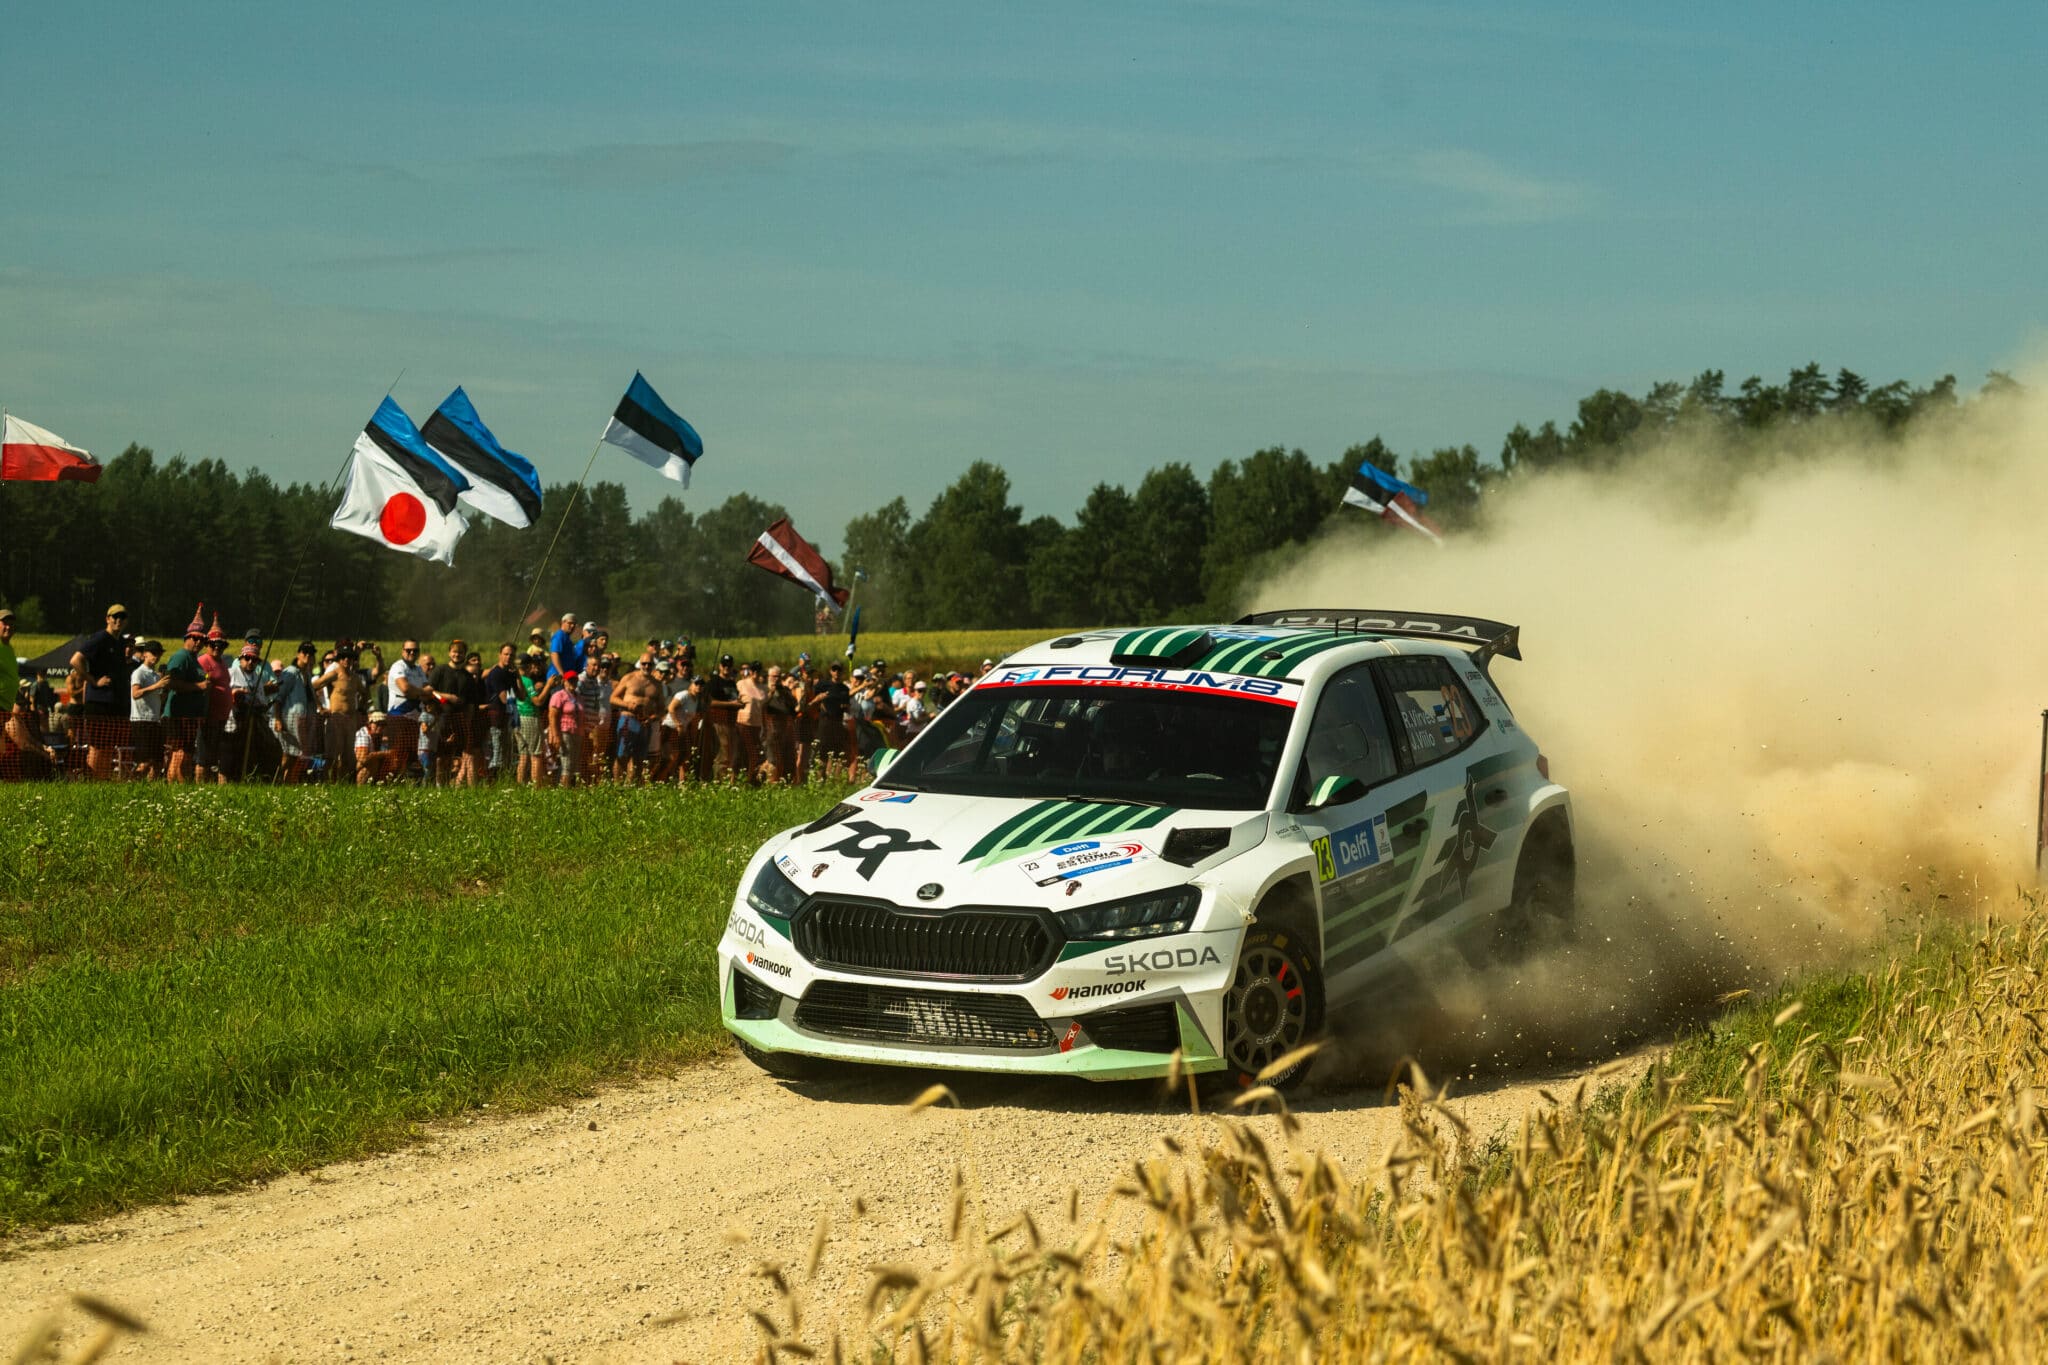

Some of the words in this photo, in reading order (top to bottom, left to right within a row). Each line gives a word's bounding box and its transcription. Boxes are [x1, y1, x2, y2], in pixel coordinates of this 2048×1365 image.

[1043, 667, 1283, 696] FORUM8
[1441, 685, 1473, 738] 23
[1056, 851, 1120, 867] ESTONIA
[1063, 844, 1089, 853] Delfi
[1313, 837, 1335, 881] 23
[1339, 831, 1371, 865] Delfi
[1024, 862, 1040, 871] 23
